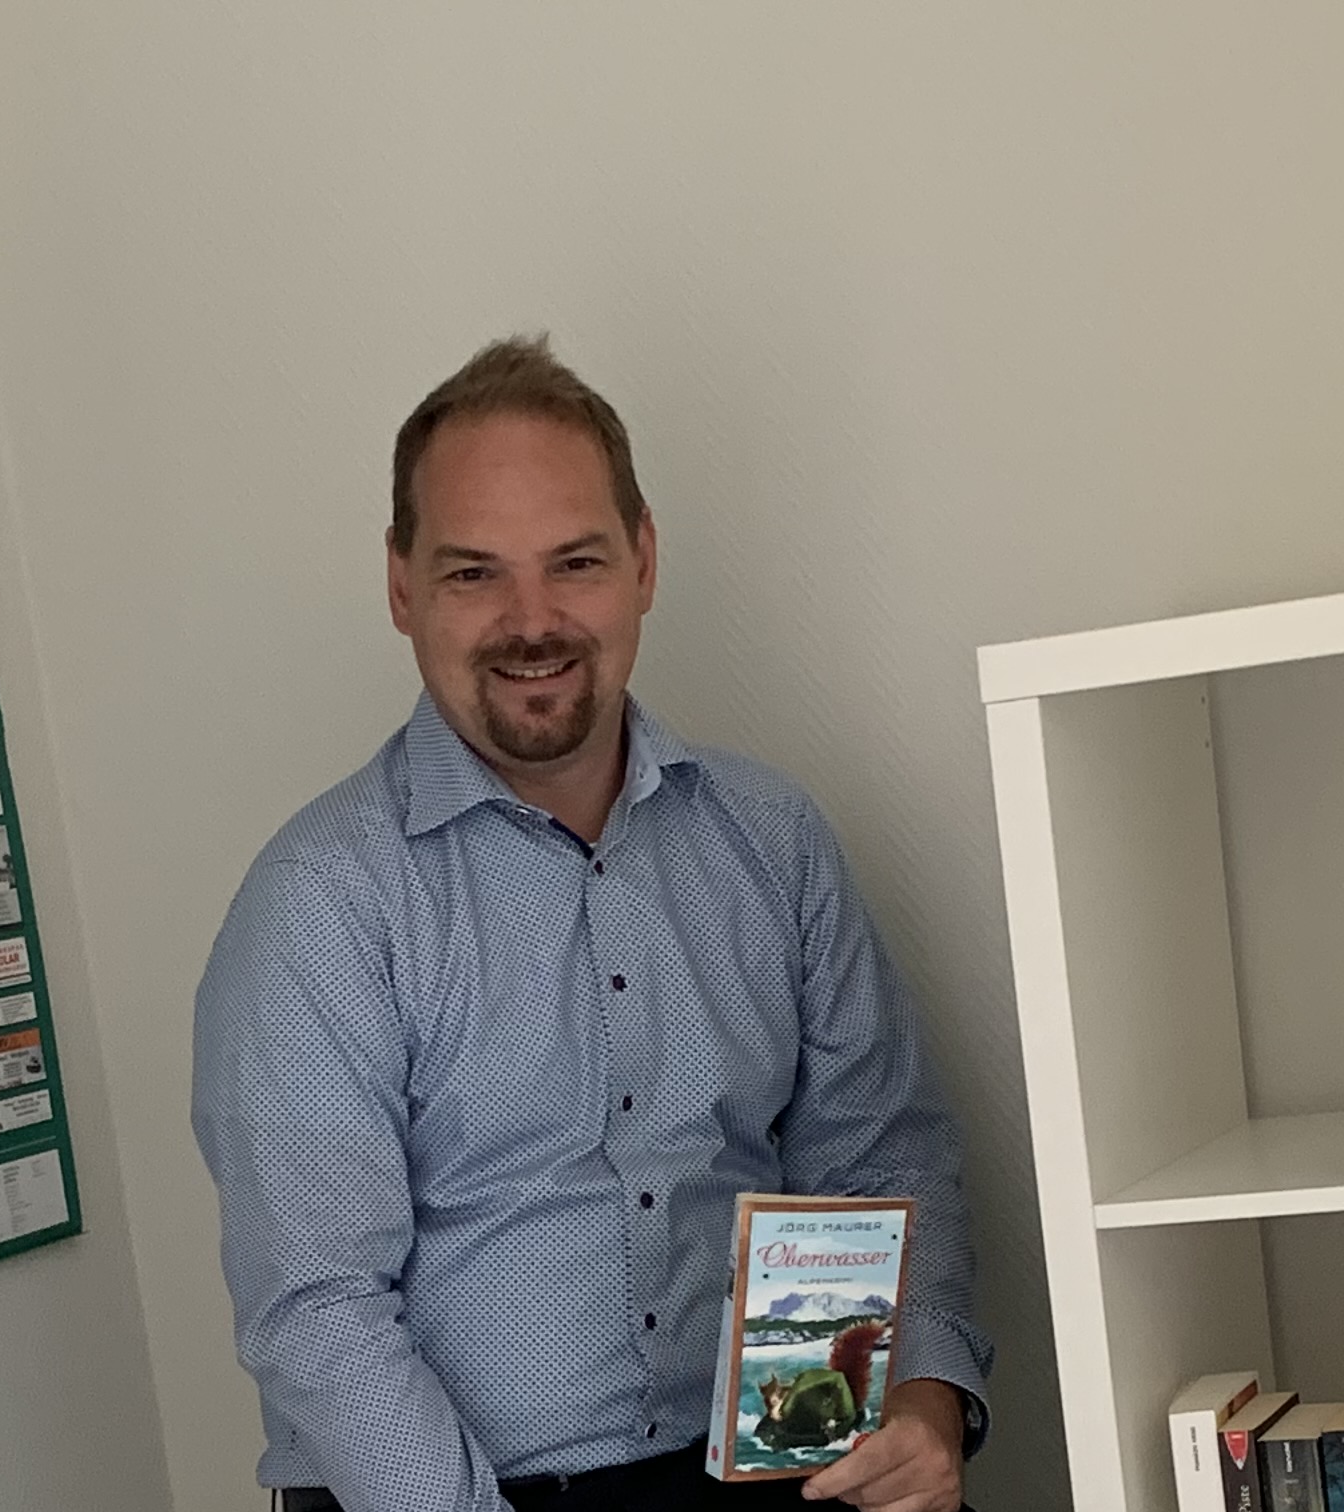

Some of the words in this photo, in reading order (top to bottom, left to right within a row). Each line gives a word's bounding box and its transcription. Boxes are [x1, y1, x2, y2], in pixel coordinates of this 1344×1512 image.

[776, 1221, 817, 1234] JÖRG
[821, 1220, 884, 1233] MAURER
[756, 1240, 894, 1269] Oberwasser
